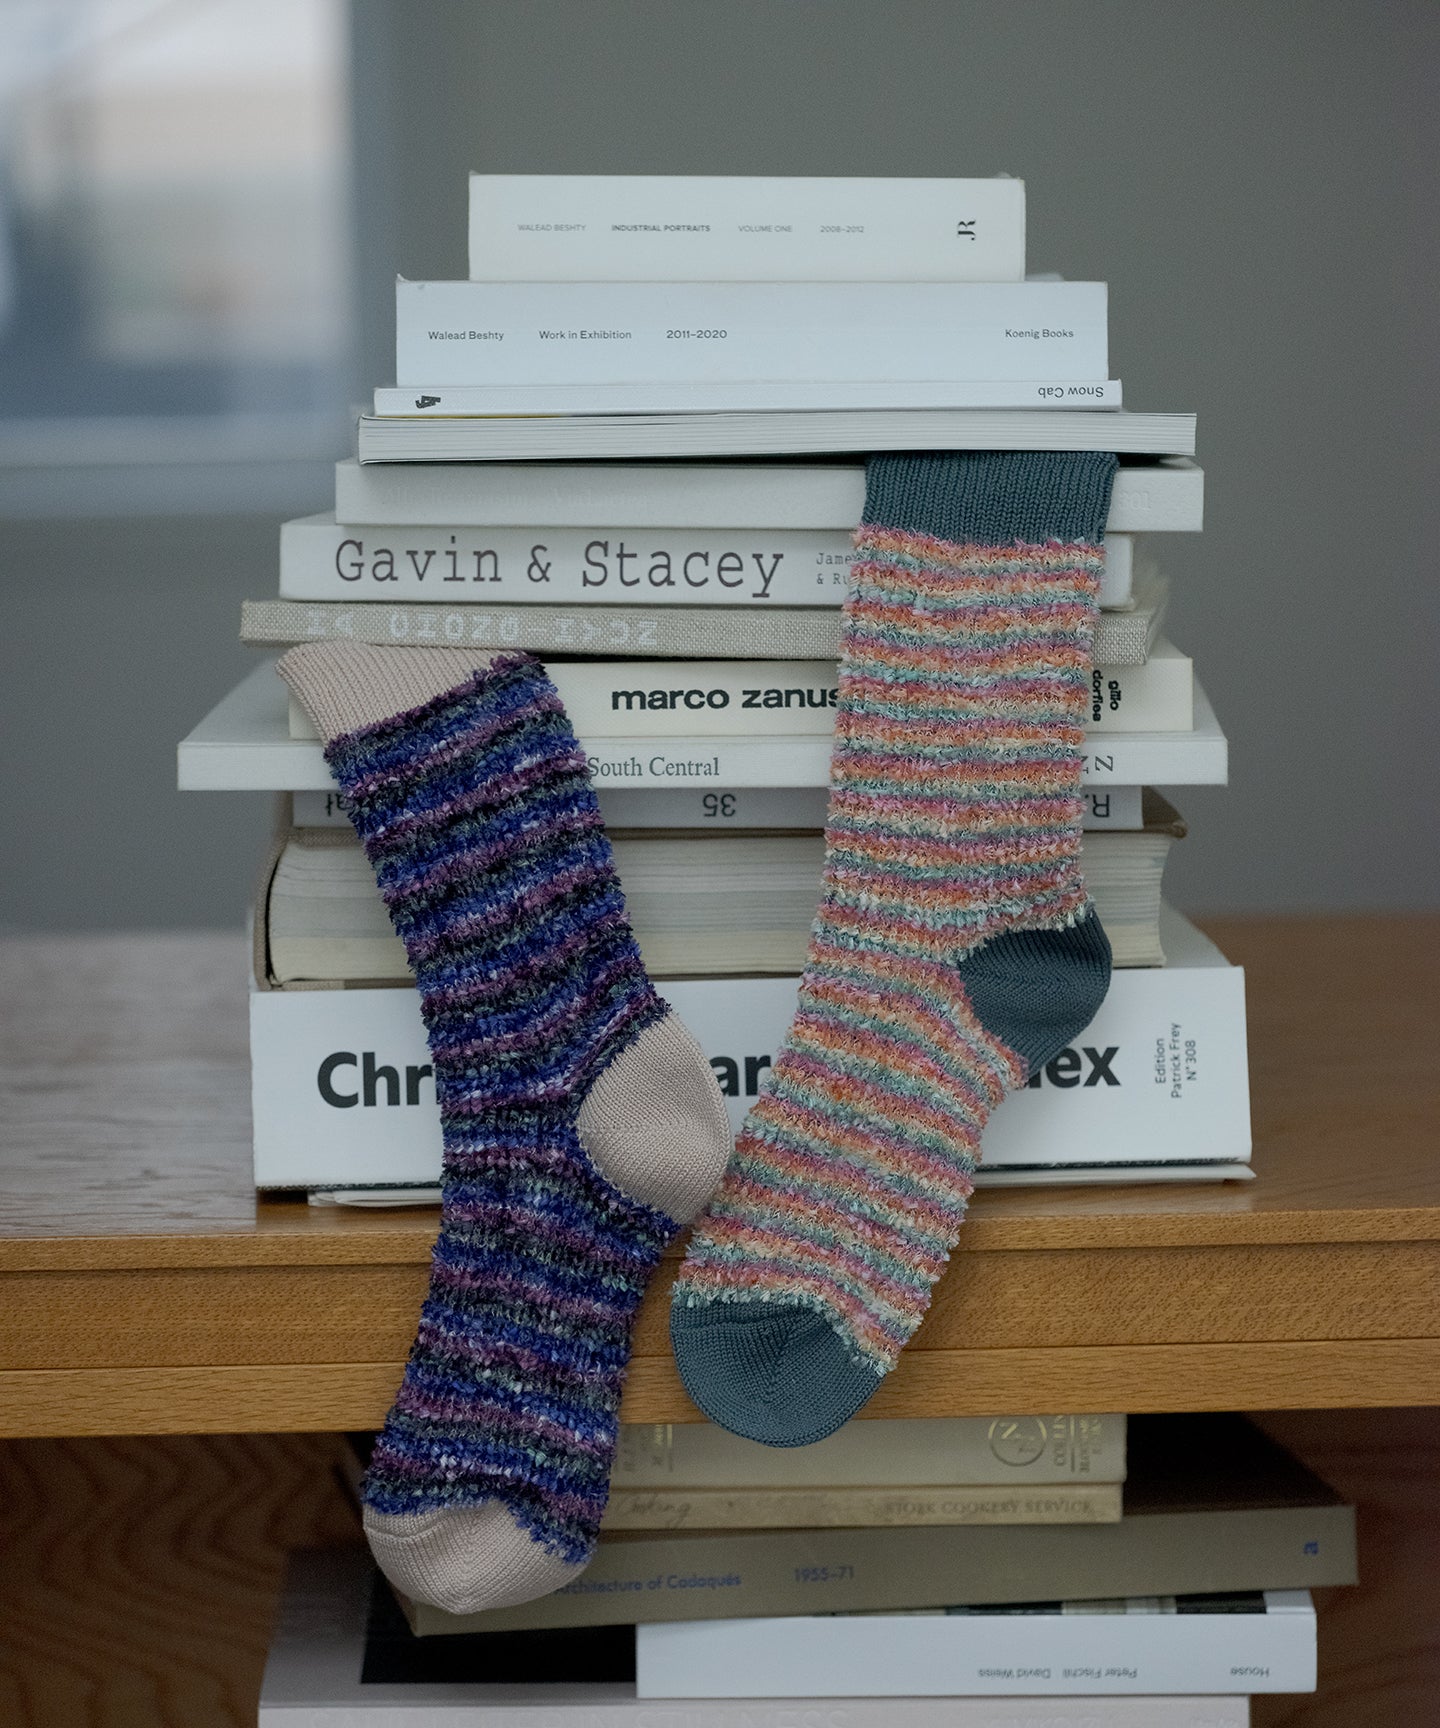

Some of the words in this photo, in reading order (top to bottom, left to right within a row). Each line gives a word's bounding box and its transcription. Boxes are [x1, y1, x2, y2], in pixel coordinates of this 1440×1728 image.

[517, 224, 552, 232] WALEAD
[554, 224, 587, 232] BESHTY
[611, 224, 662, 232] INDUSTRIAL
[664, 224, 711, 232] PORTRAITS
[738, 225, 773, 233] VOLUME
[774, 225, 793, 233] ONE
[428, 330, 466, 340] Walead
[468, 330, 504, 342] Beshty
[539, 329, 566, 340] Work
[568, 329, 578, 340] in
[580, 329, 632, 340] Exhibition
[1005, 328, 1040, 340] Koenig
[1042, 328, 1074, 338] Books
[1038, 386, 1065, 398] Cab
[1067, 386, 1104, 398] Snow
[816, 552, 852, 565] Jame
[335, 535, 502, 583] Gavin
[527, 544, 552, 583] &
[582, 540, 785, 599] Stacey
[611, 688, 731, 711] marco
[741, 688, 839, 710] zanus
[587, 756, 644, 777] South
[649, 756, 721, 777] Central
[702, 793, 737, 818] 35
[1168, 1021, 1182, 1051] Frey
[1154, 1038, 1167, 1084] Edition
[1169, 1053, 1182, 1099] Patrick
[647, 1575, 663, 1590] of
[1016, 1667, 1051, 1679] David
[1104, 1667, 1138, 1679] Peter
[1230, 1667, 1270, 1677] House
